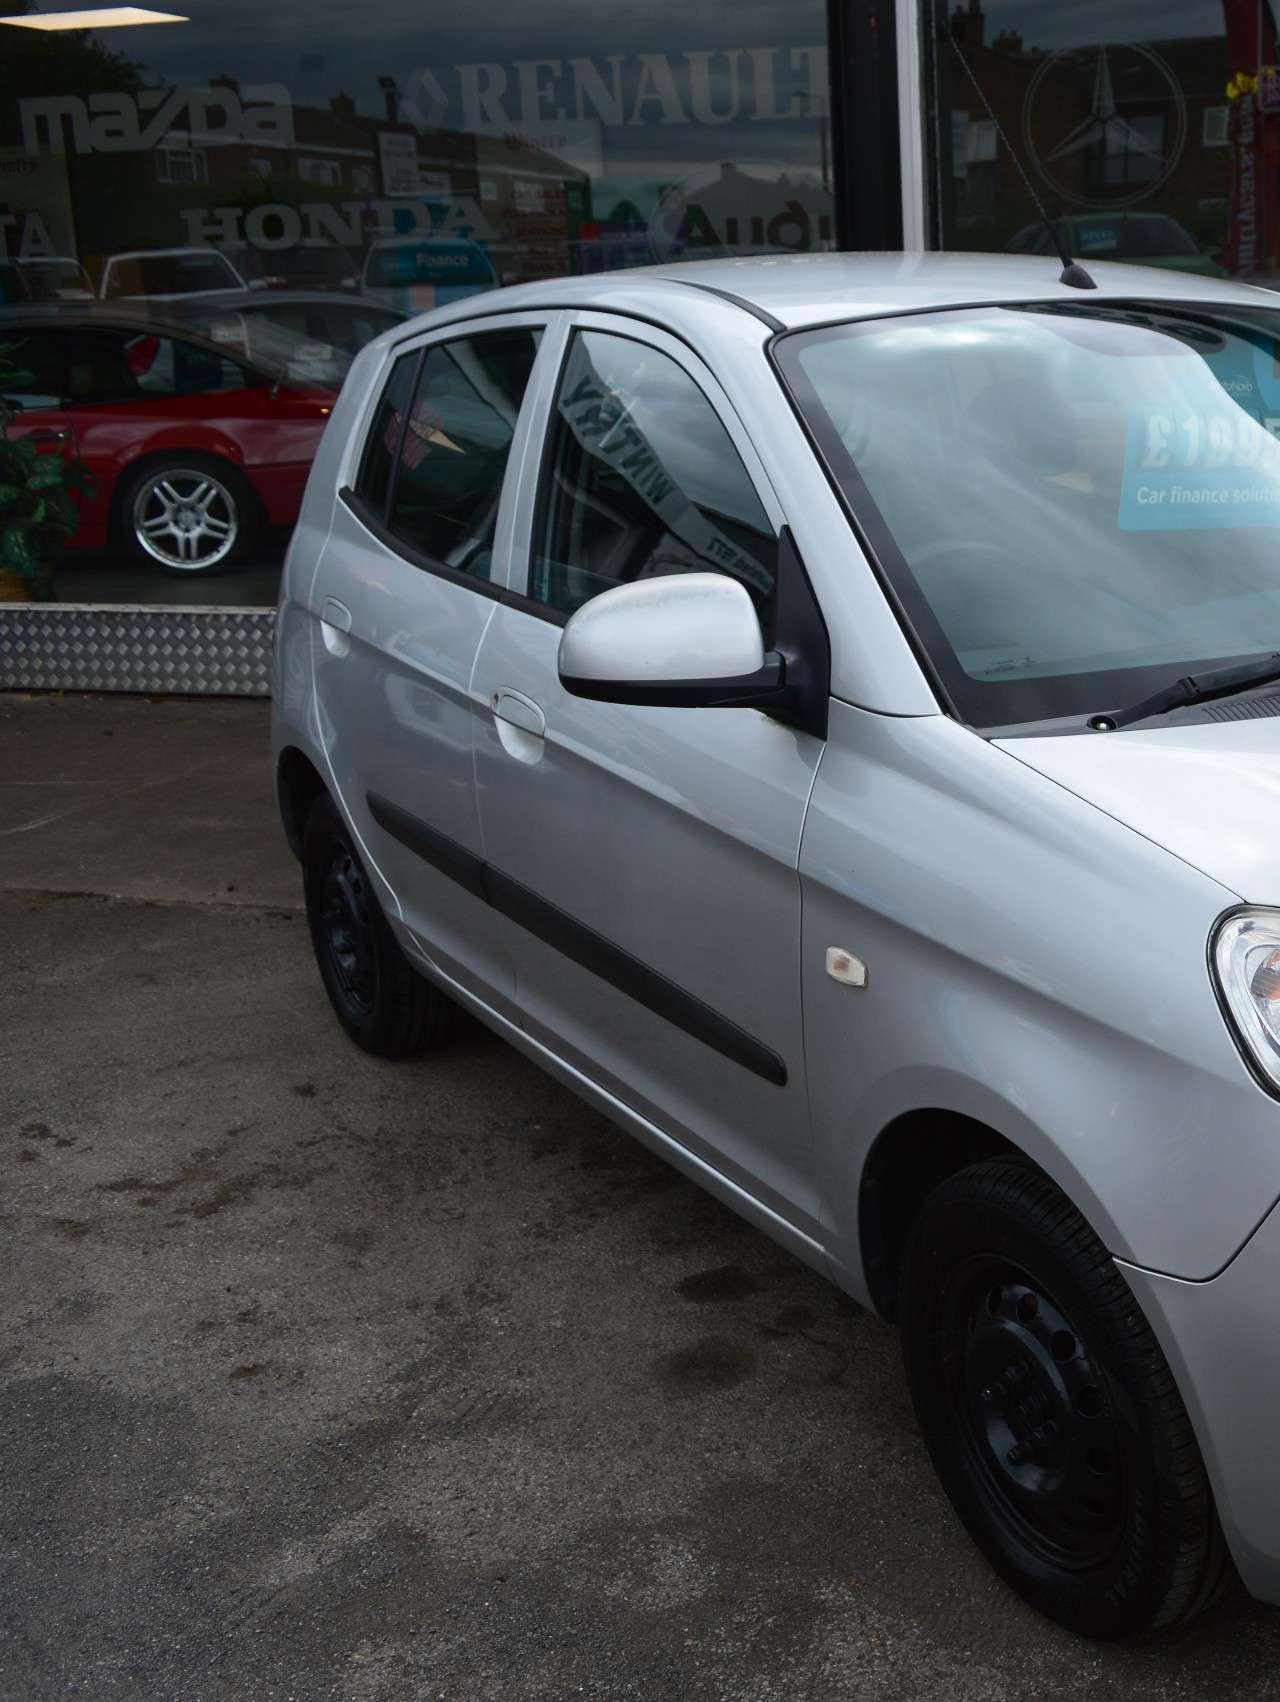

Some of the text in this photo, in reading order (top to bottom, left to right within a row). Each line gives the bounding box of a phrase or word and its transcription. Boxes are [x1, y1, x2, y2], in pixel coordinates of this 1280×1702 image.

[18, 83, 295, 157] mazda
[453, 44, 829, 133] RENAULT
[180, 195, 501, 251] HONDA
[1136, 487, 1166, 505] Car
[1170, 485, 1229, 504] finance
